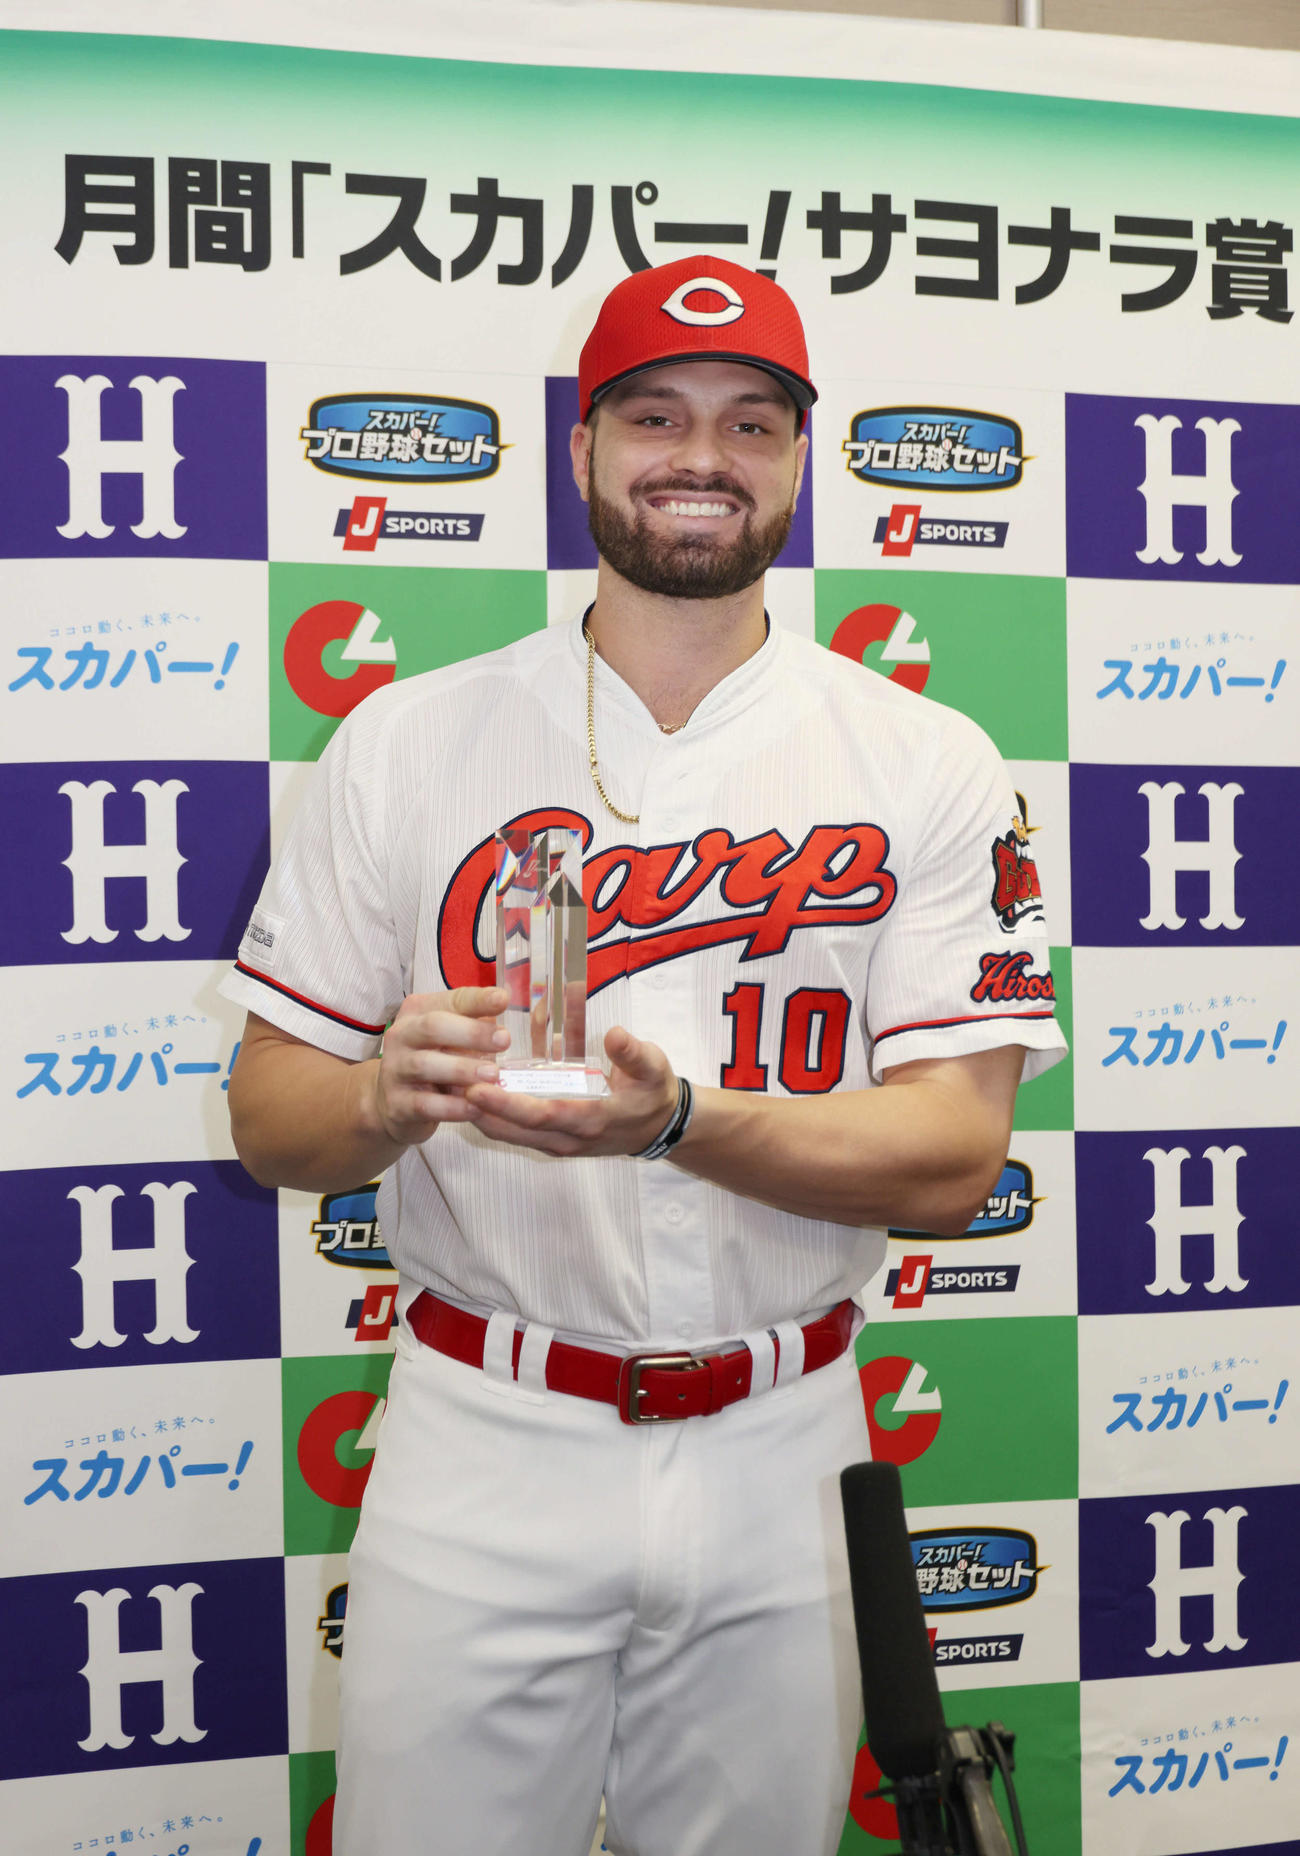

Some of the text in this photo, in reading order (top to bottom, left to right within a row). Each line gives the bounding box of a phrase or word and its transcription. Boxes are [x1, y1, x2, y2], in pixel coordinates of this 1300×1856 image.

[55, 375, 188, 539] H
[302, 428, 500, 465] プロ野球セット
[844, 440, 1022, 475] プロ野球セット
[1134, 413, 1242, 567] H
[351, 506, 471, 536] J SPORTS
[889, 514, 996, 542] J SPORTS
[8, 641, 240, 692] スカパー!
[1096, 657, 1287, 703] スカパー!
[58, 779, 191, 945] H
[1138, 782, 1245, 930] H
[438, 806, 898, 1001] Carp
[56, 1014, 207, 1043] ココロ動く、未来へ。
[1134, 996, 1257, 1019] ココロ動く、未来へ。
[720, 981, 852, 1094] 10
[1102, 1021, 1287, 1067] スカパー!
[1143, 1146, 1249, 1296] H
[67, 1181, 200, 1350] H
[901, 1265, 1008, 1294] J SPORTS
[364, 1296, 392, 1326] J
[1139, 1357, 1260, 1384] ココロ動く、未来へ。
[1106, 1380, 1289, 1434] スカパー!
[64, 1416, 215, 1449] ココロ動く、未来へ。
[24, 1440, 254, 1506] スカパー!
[1145, 1505, 1249, 1658] H
[74, 1582, 208, 1752] H
[936, 1641, 1011, 1661] SPORTS
[1139, 1715, 1261, 1747] ココロ動く、未来へ。
[1108, 1736, 1289, 1798] スカパー!
[72, 1815, 224, 1851] ココロ動く、未来へ。
